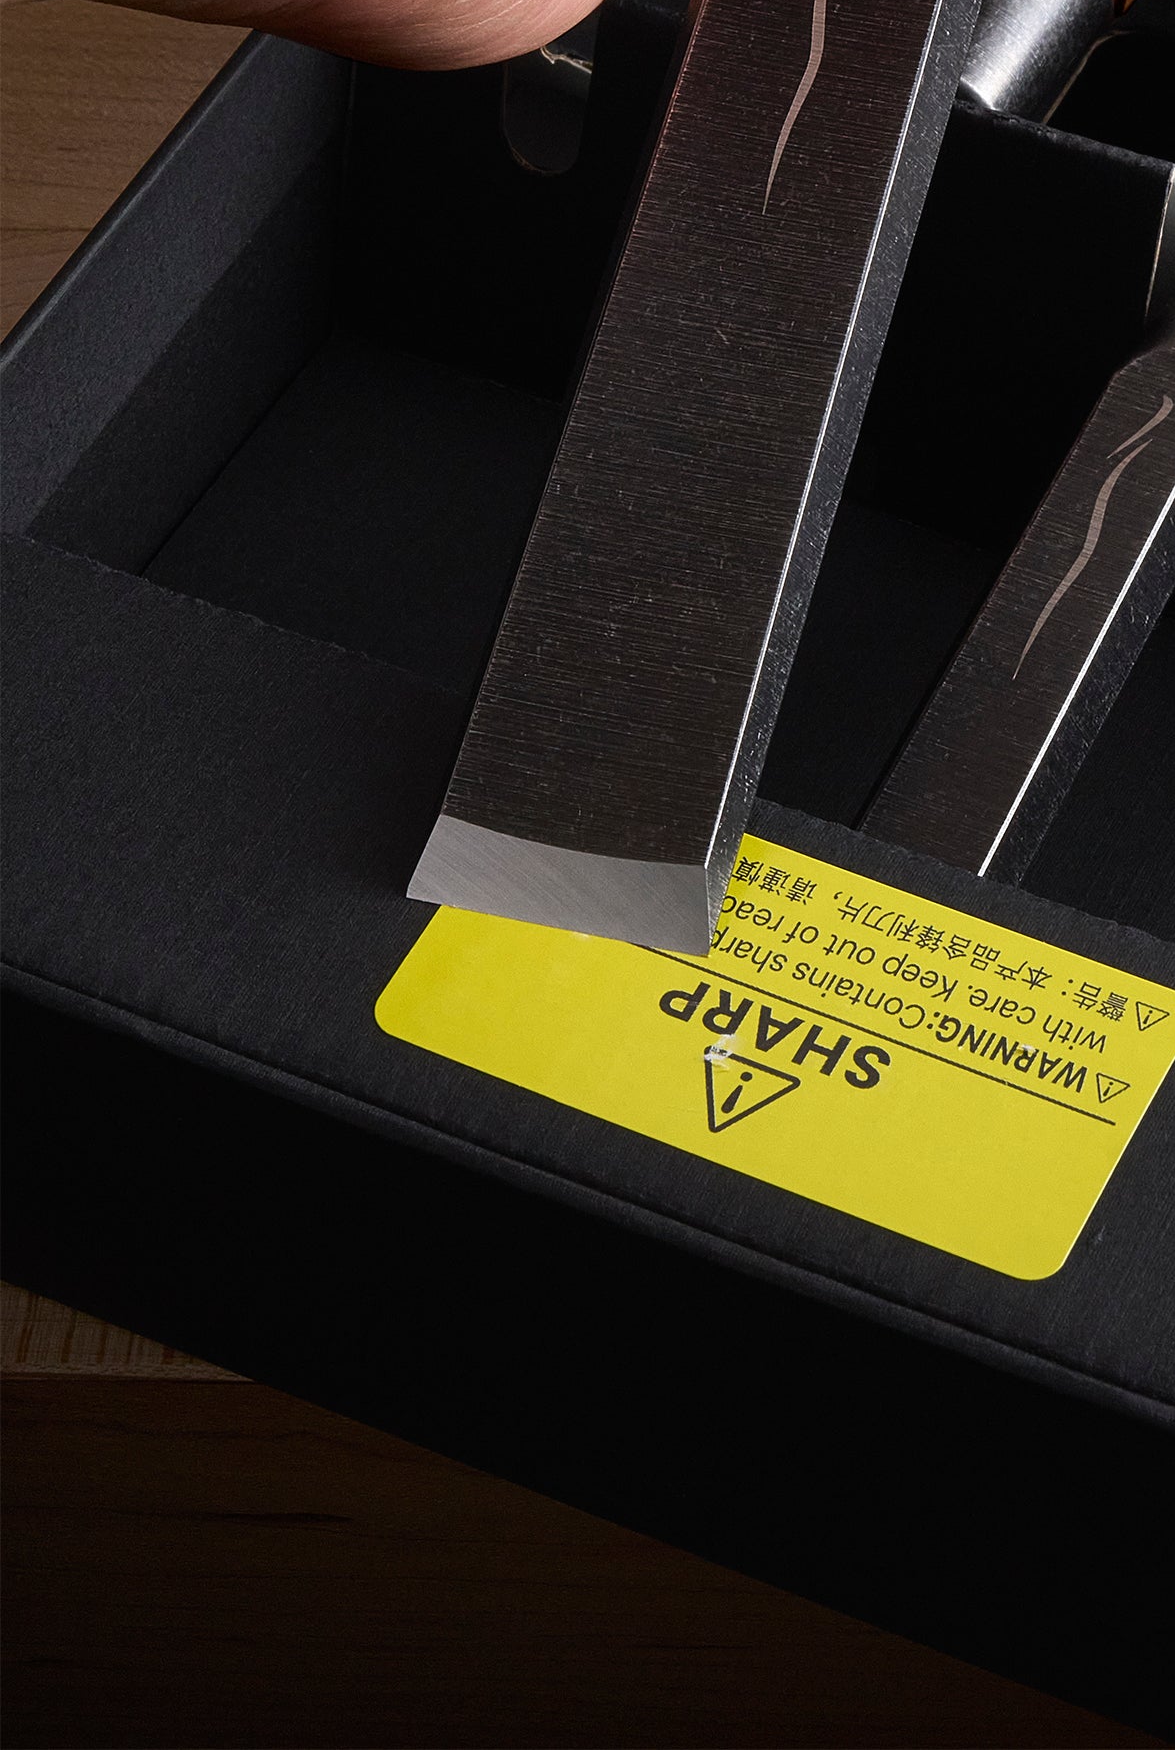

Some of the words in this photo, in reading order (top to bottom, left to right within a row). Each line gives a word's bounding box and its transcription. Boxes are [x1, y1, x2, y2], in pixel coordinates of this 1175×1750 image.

[721, 895, 784, 931] reac
[781, 921, 819, 945] of
[711, 927, 787, 973] sharp
[823, 934, 875, 964] out
[792, 963, 925, 1029] Contains
[883, 954, 958, 1002] Keep
[968, 985, 1035, 1024] care.
[659, 982, 890, 1089] SHARP
[927, 1012, 1087, 1093] WARNING:
[1043, 1015, 1106, 1053] with
